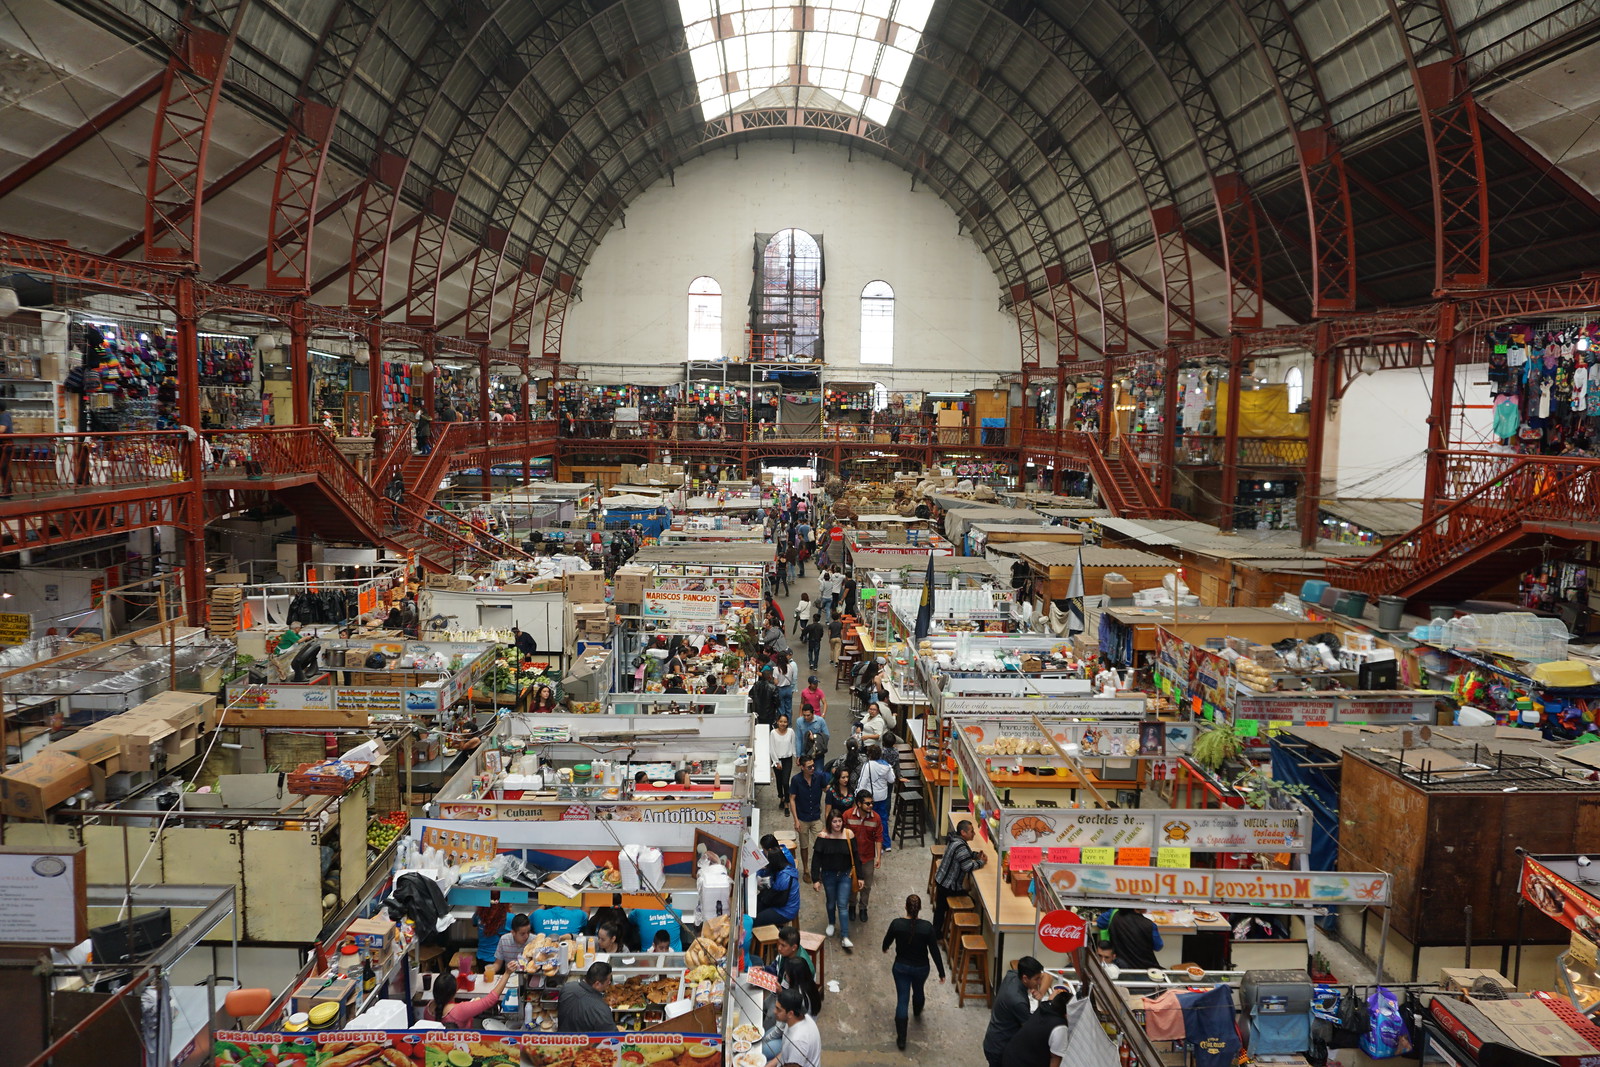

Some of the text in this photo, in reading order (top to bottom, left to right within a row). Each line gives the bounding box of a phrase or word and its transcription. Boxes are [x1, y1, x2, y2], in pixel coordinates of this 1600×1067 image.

[645, 592, 717, 603] MARISCOS PANCHO'S
[946, 701, 1090, 710] Dulce vida Dulce vida
[444, 805, 492, 817] TORTAS
[643, 808, 716, 824] Antojitos
[1077, 815, 1119, 825] Cocteles
[1281, 818, 1299, 828] VIDA
[229, 833, 236, 845] 3
[1055, 823, 1076, 843] CAMARON
[1090, 828, 1105, 843] PULPO
[1125, 826, 1143, 844] CARACOL
[311, 834, 318, 846] 3
[1040, 923, 1083, 939] Coca-Cola
[1433, 1006, 1455, 1030] Coca-Cola
[319, 1032, 387, 1043] BAGUETTE
[522, 1034, 588, 1045] PECHUGAS
[626, 1034, 683, 1045] COMIDAS
